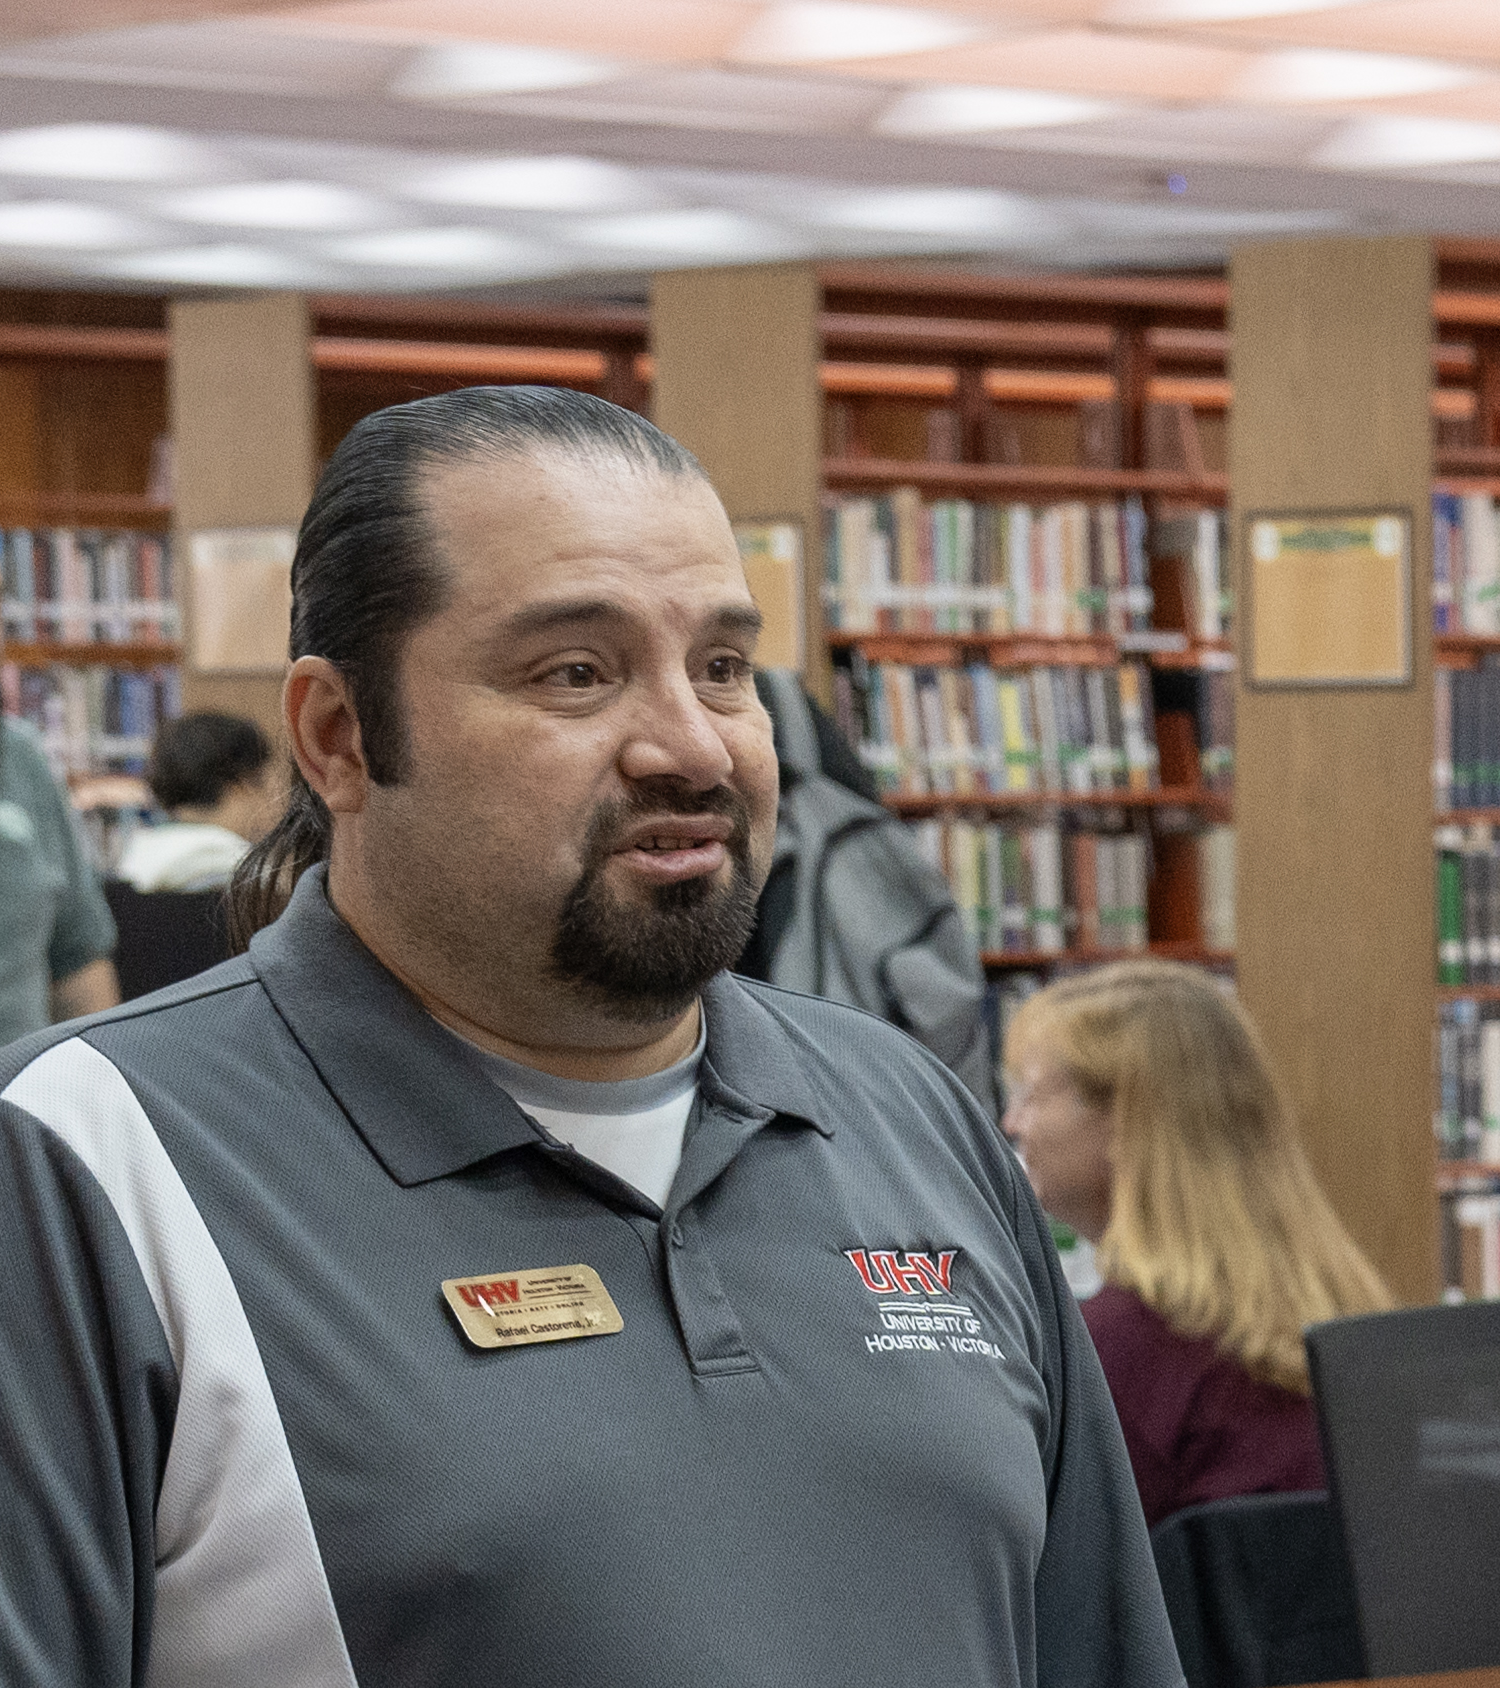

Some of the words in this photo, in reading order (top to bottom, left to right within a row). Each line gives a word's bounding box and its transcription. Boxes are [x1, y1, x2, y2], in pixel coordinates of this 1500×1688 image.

[844, 1249, 958, 1296] UHV
[455, 1279, 521, 1308] UHV
[496, 1325, 530, 1338] Rafael
[880, 1313, 963, 1333] UNIVERSITY
[865, 1334, 941, 1353] HOUSTON
[947, 1335, 1007, 1360] VICTORIA
